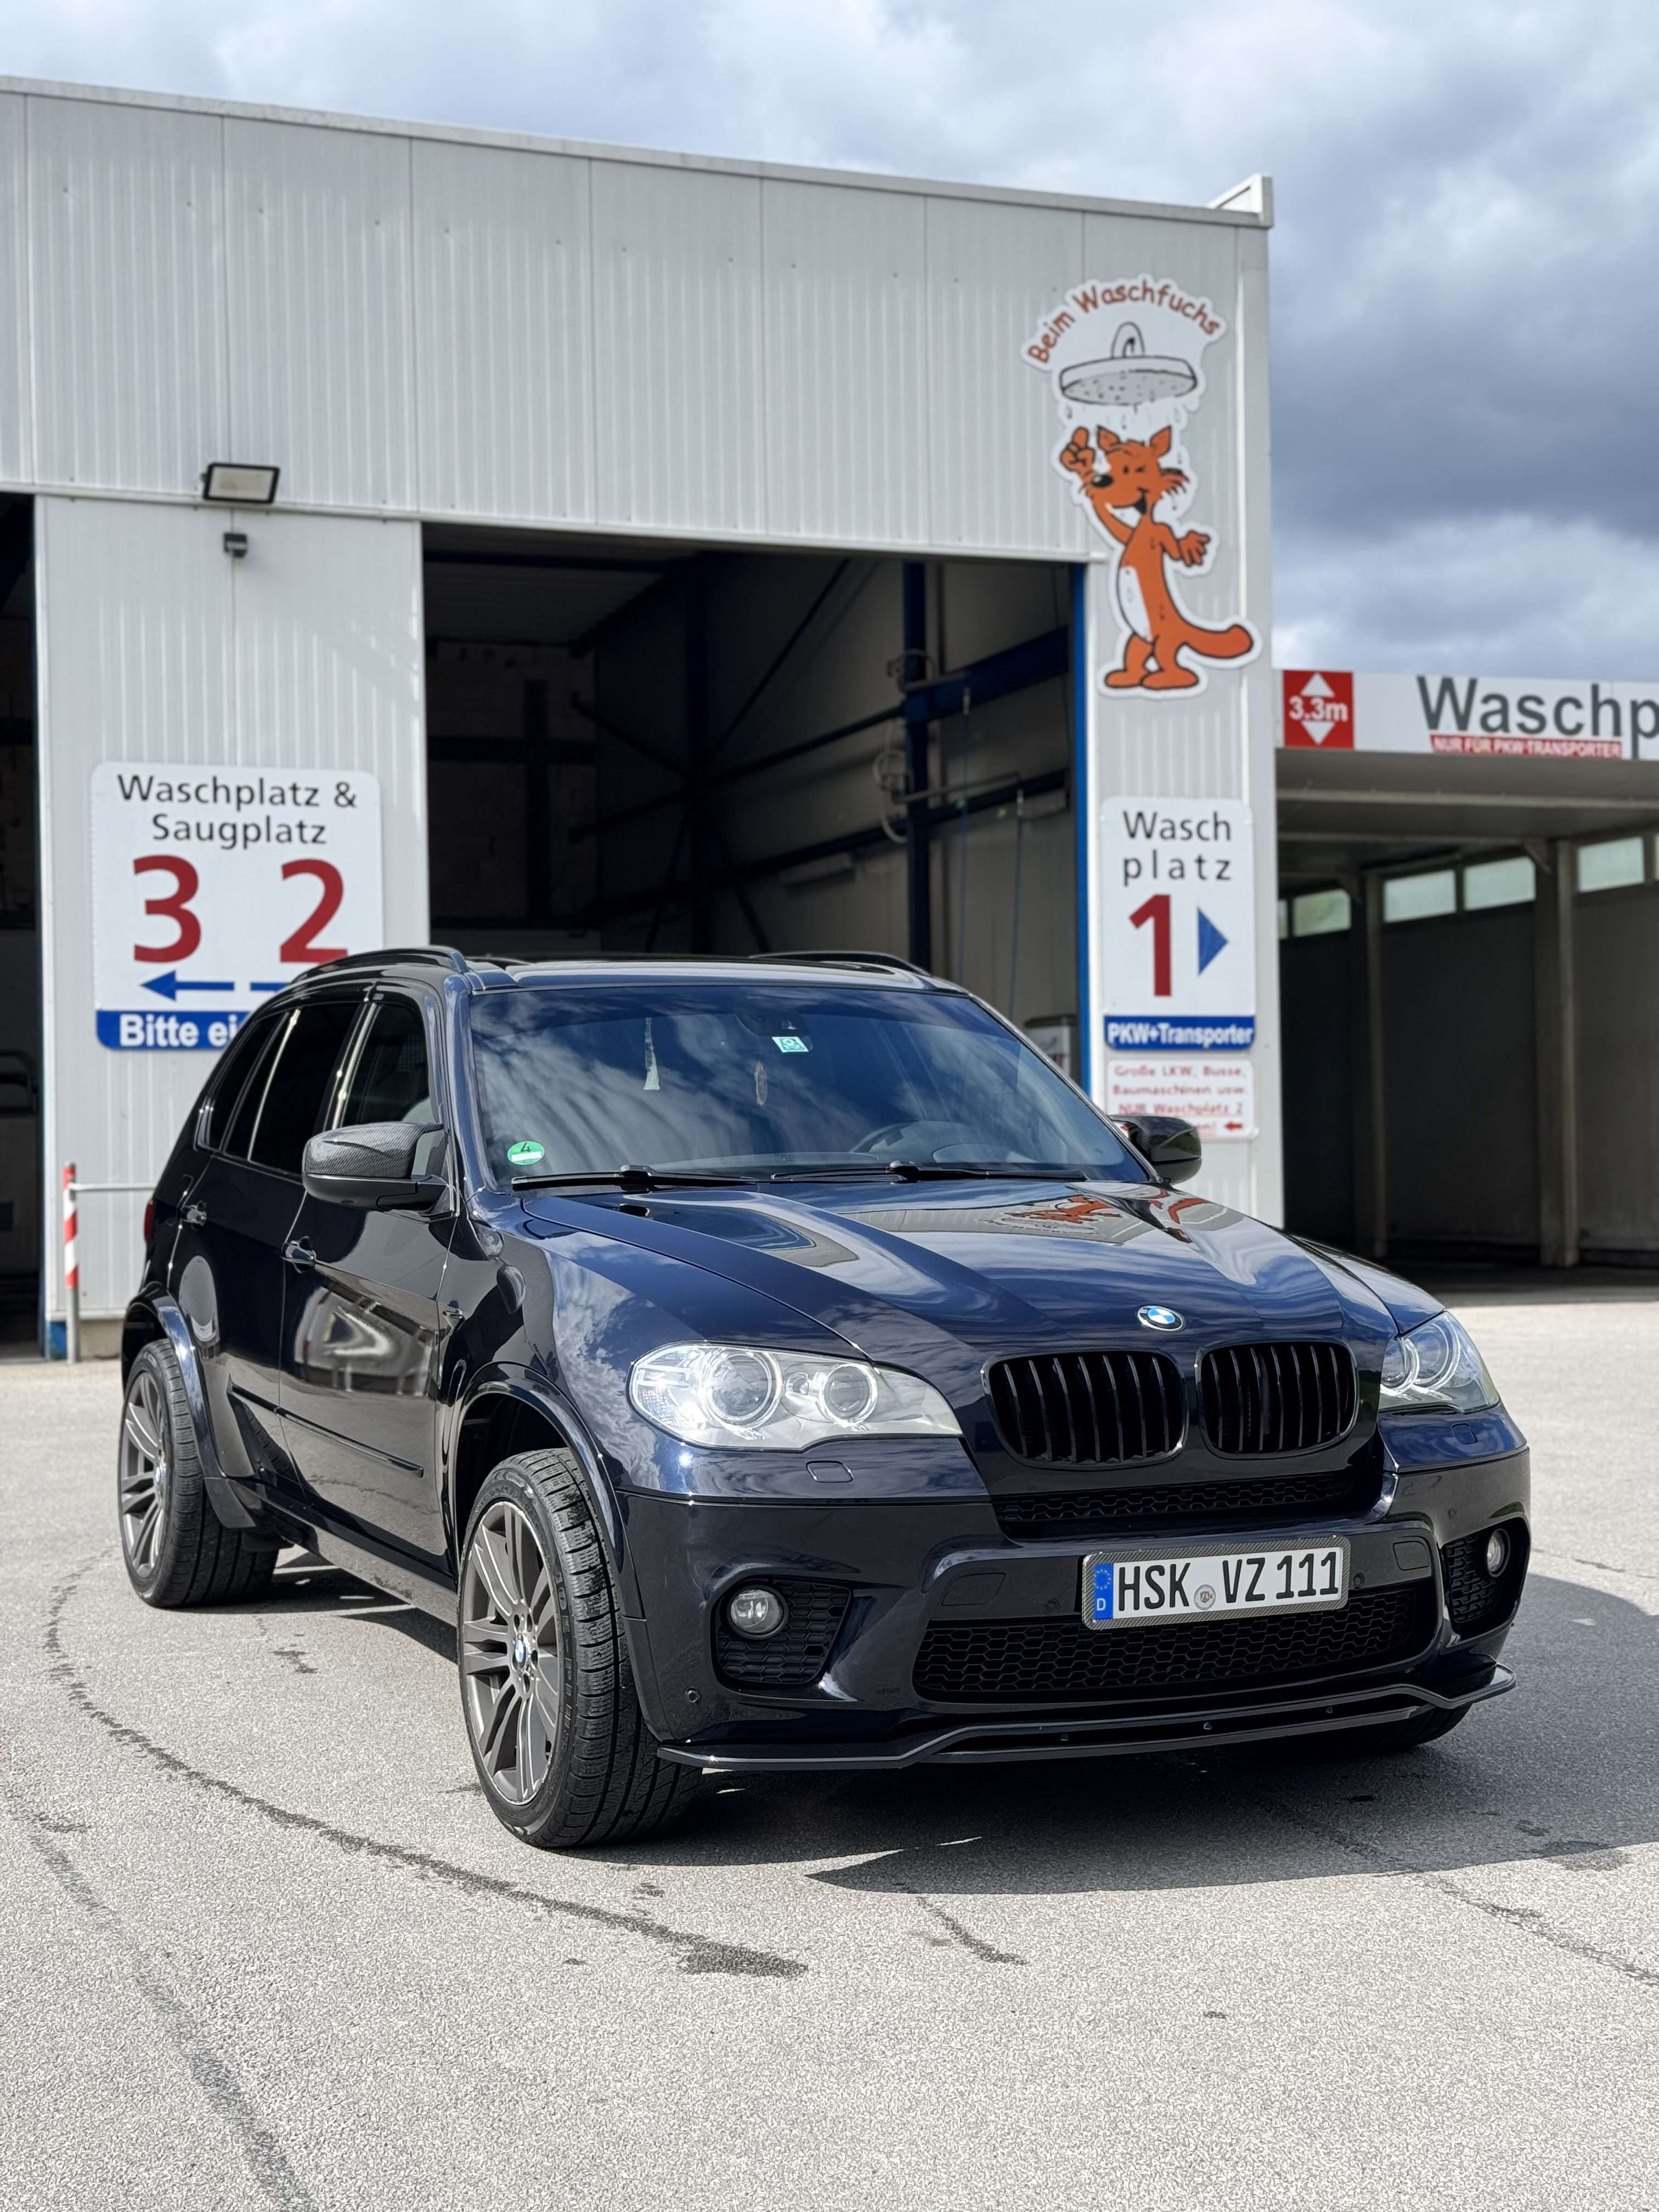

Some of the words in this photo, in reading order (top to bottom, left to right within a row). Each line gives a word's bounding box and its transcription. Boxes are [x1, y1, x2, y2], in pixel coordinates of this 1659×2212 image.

[1028, 311, 1075, 363] Beim
[1072, 279, 1220, 335] Waschfuchs
[1288, 695, 1348, 722] 3.3m
[1416, 675, 1659, 760] Waschp
[117, 775, 320, 812] Waschplatz
[334, 782, 358, 808] &
[152, 813, 326, 850] Saugplatz
[1122, 811, 1232, 842] Wasch
[1123, 849, 1231, 887] platz
[133, 855, 201, 963] 3
[279, 859, 348, 963] 2
[1128, 894, 1172, 997] 1
[119, 1013, 199, 1047] Bitte
[1108, 1022, 1254, 1048] PKW+Transporter
[1119, 1562, 1191, 1611] HSK
[1222, 1557, 1266, 1604] VZ
[1276, 1551, 1339, 1599] 111
[1096, 1598, 1107, 1611] D
